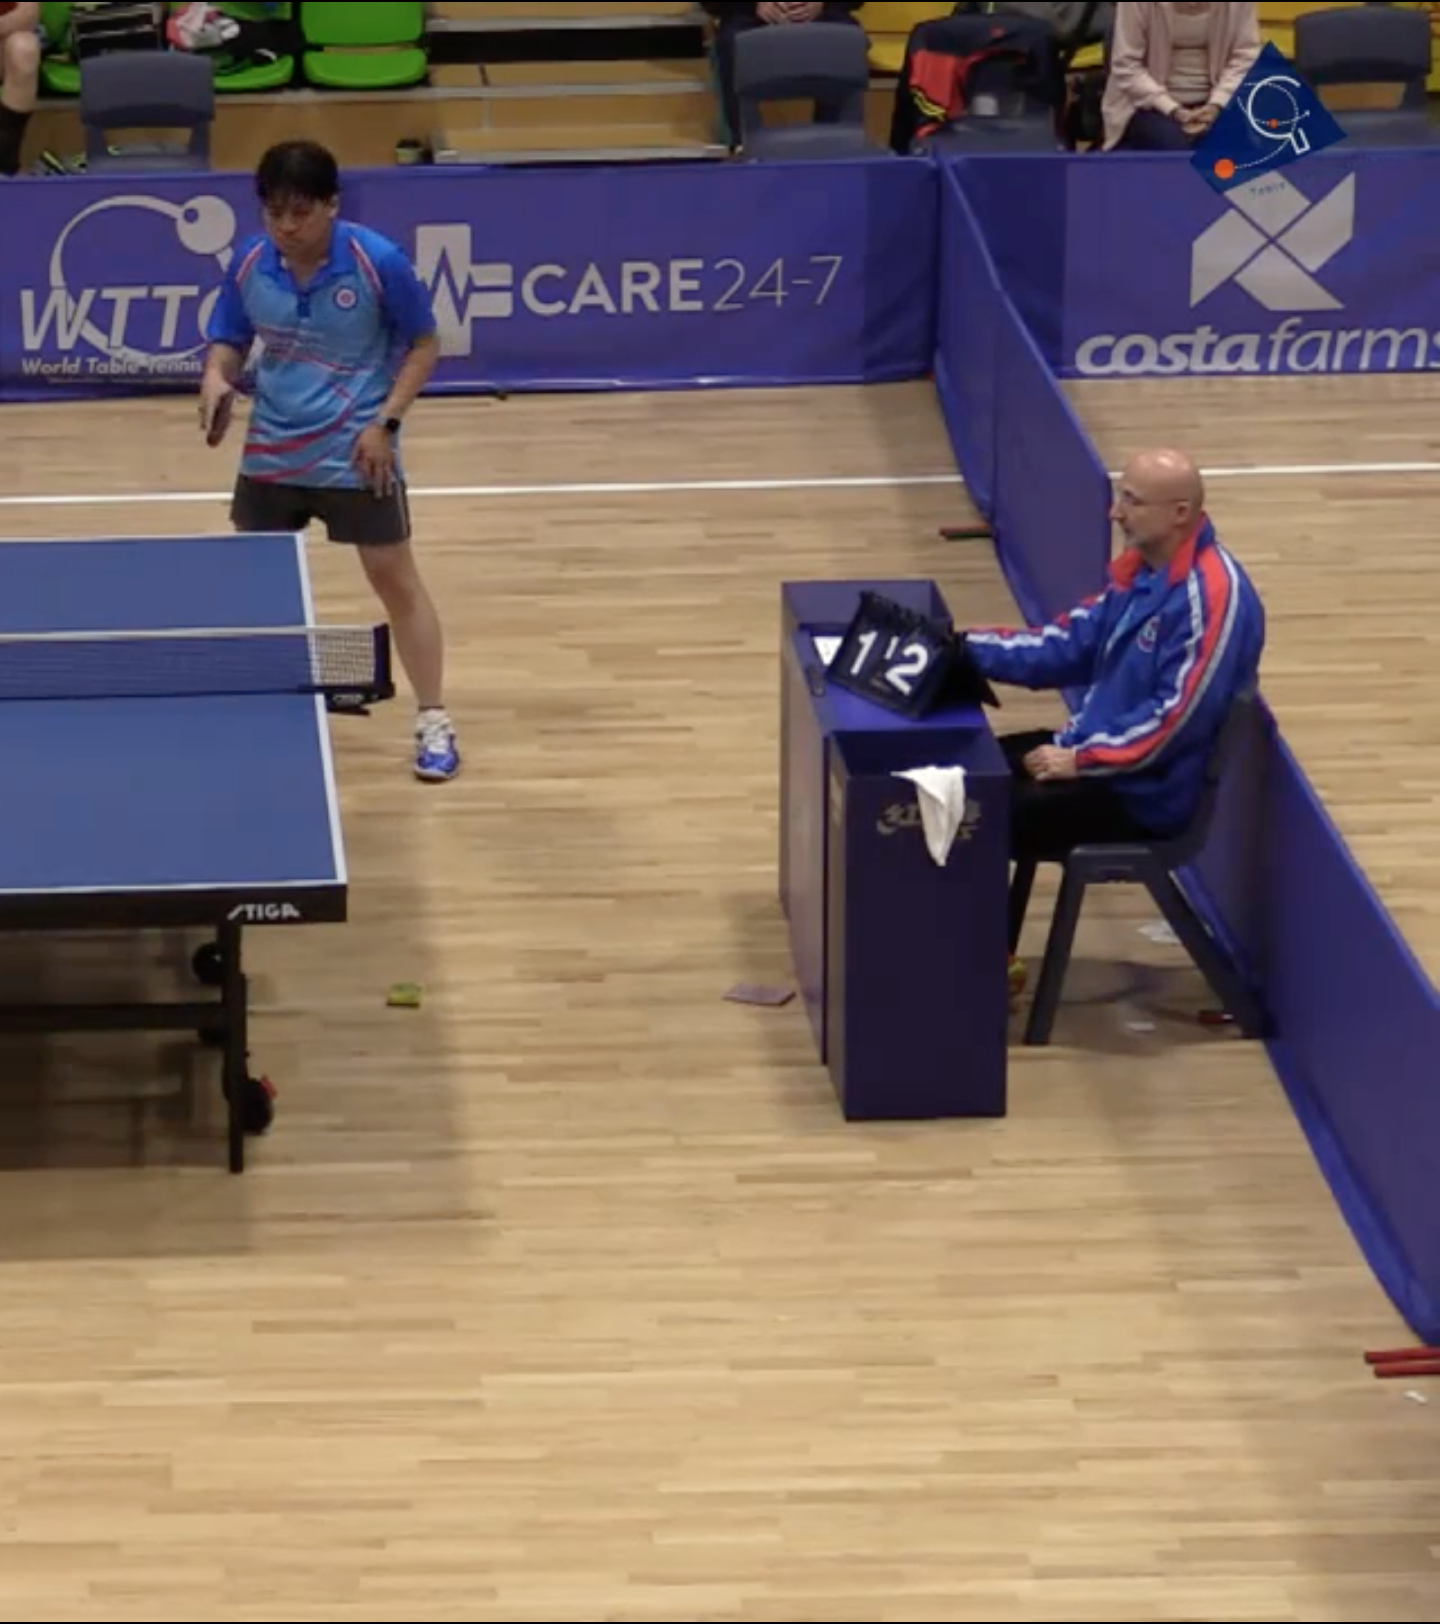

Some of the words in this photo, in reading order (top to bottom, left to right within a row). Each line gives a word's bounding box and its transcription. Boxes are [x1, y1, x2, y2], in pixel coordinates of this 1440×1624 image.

[21, 357, 80, 375] World
[1074, 317, 1440, 375] costafarm
[850, 631, 878, 675] 1
[885, 643, 928, 695] 2
